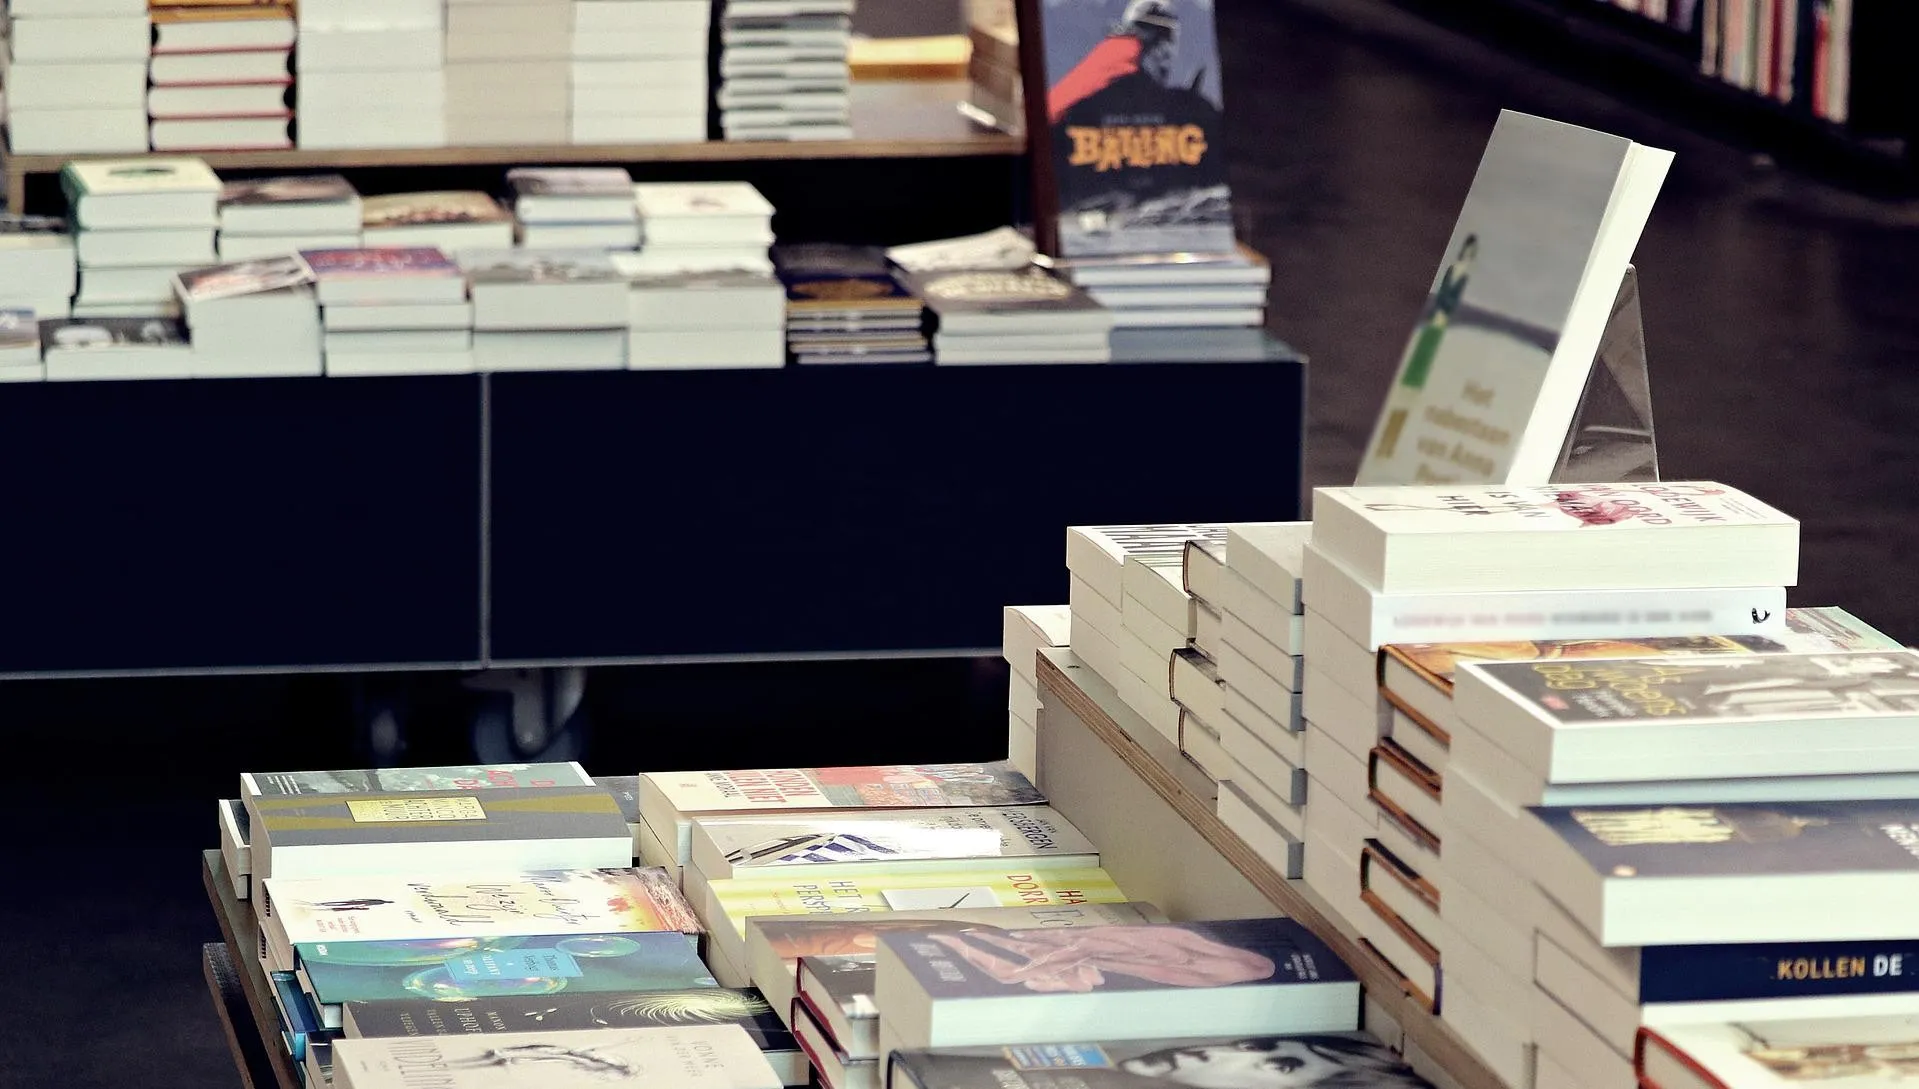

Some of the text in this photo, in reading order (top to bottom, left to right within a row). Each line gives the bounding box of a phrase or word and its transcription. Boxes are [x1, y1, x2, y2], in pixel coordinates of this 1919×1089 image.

[1437, 495, 1492, 516] HIER
[1611, 499, 1673, 525] OORD
[1632, 484, 1727, 522] LODEWIJK
[741, 788, 788, 802] NIET
[466, 885, 527, 915] We zijn
[829, 881, 863, 900] HET
[407, 883, 494, 926] verdwaald
[1778, 955, 1902, 980] KOLLEN DE
[454, 1008, 482, 1032] UPHOF
[387, 1040, 457, 1089] VINDELIN
